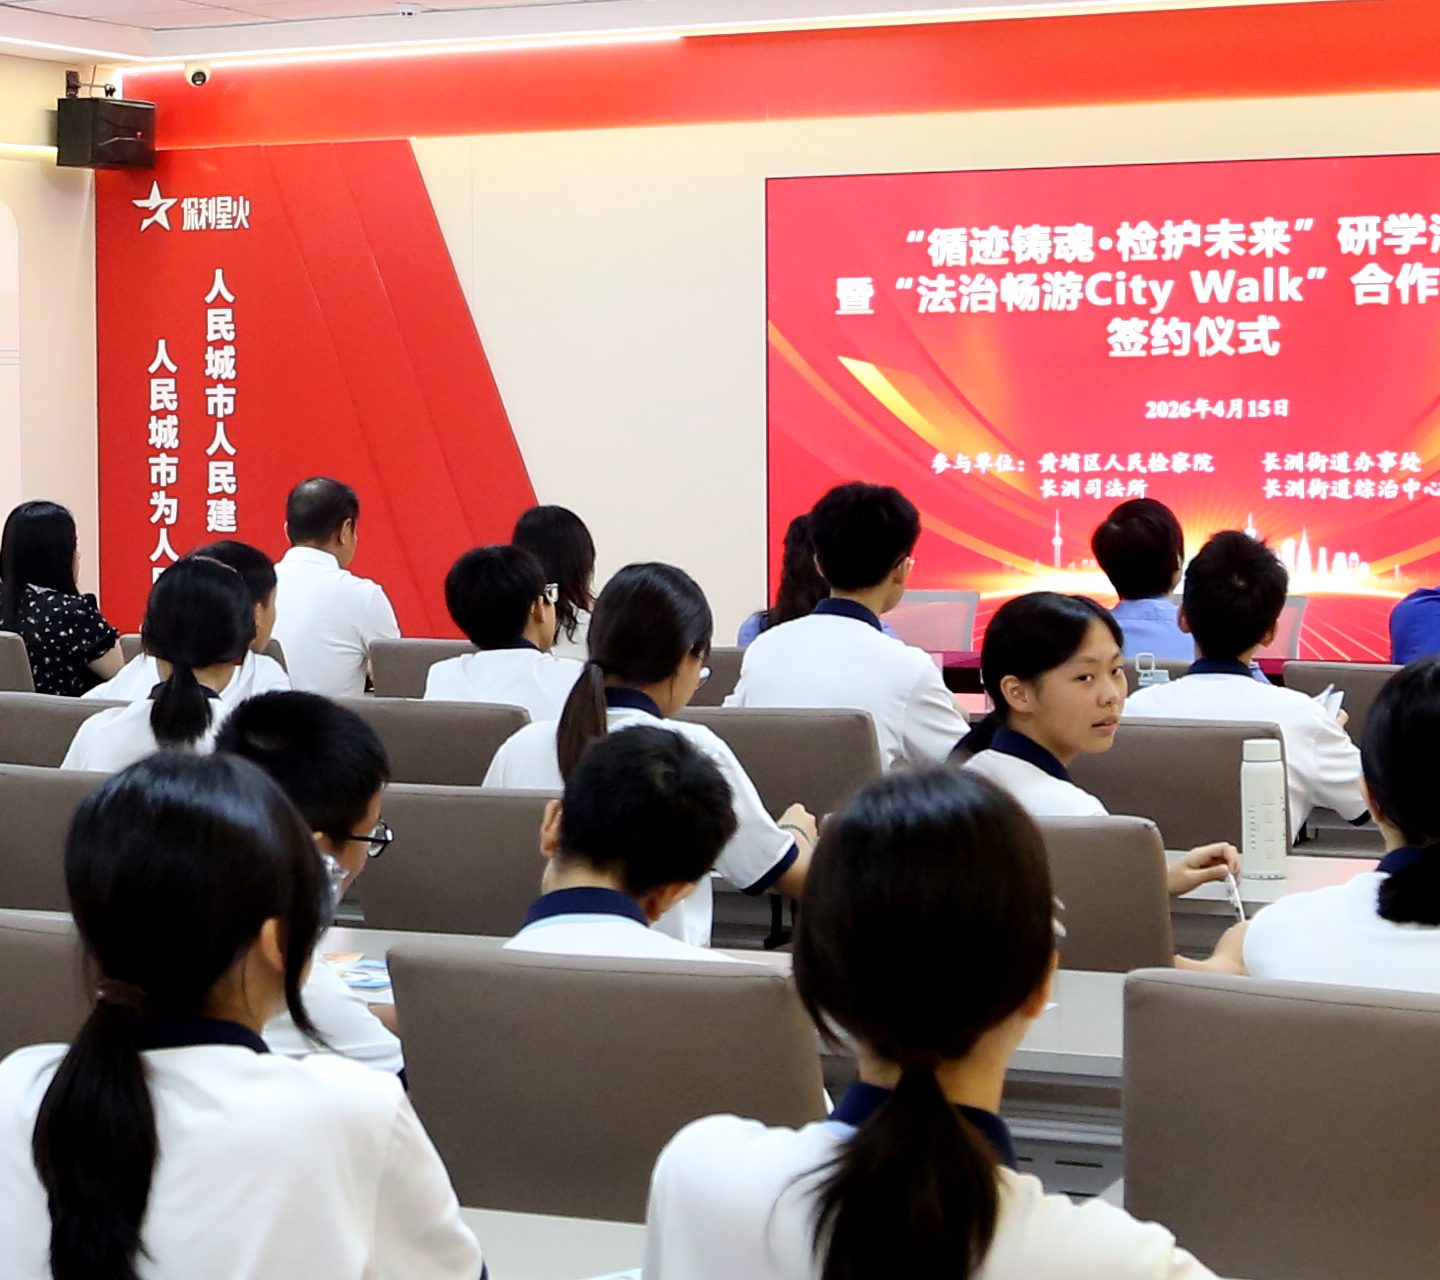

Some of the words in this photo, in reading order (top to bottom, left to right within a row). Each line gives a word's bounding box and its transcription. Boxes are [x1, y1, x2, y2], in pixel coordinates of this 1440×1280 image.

[180, 194, 252, 232] 保利星火
[1105, 316, 1282, 359] 签约仪式
[204, 268, 238, 534] 人民城市人民建
[1144, 398, 1291, 420] 2026年4月15日
[1261, 450, 1423, 473] 长洲街道办事处
[1039, 477, 1149, 500] 长洲司法所
